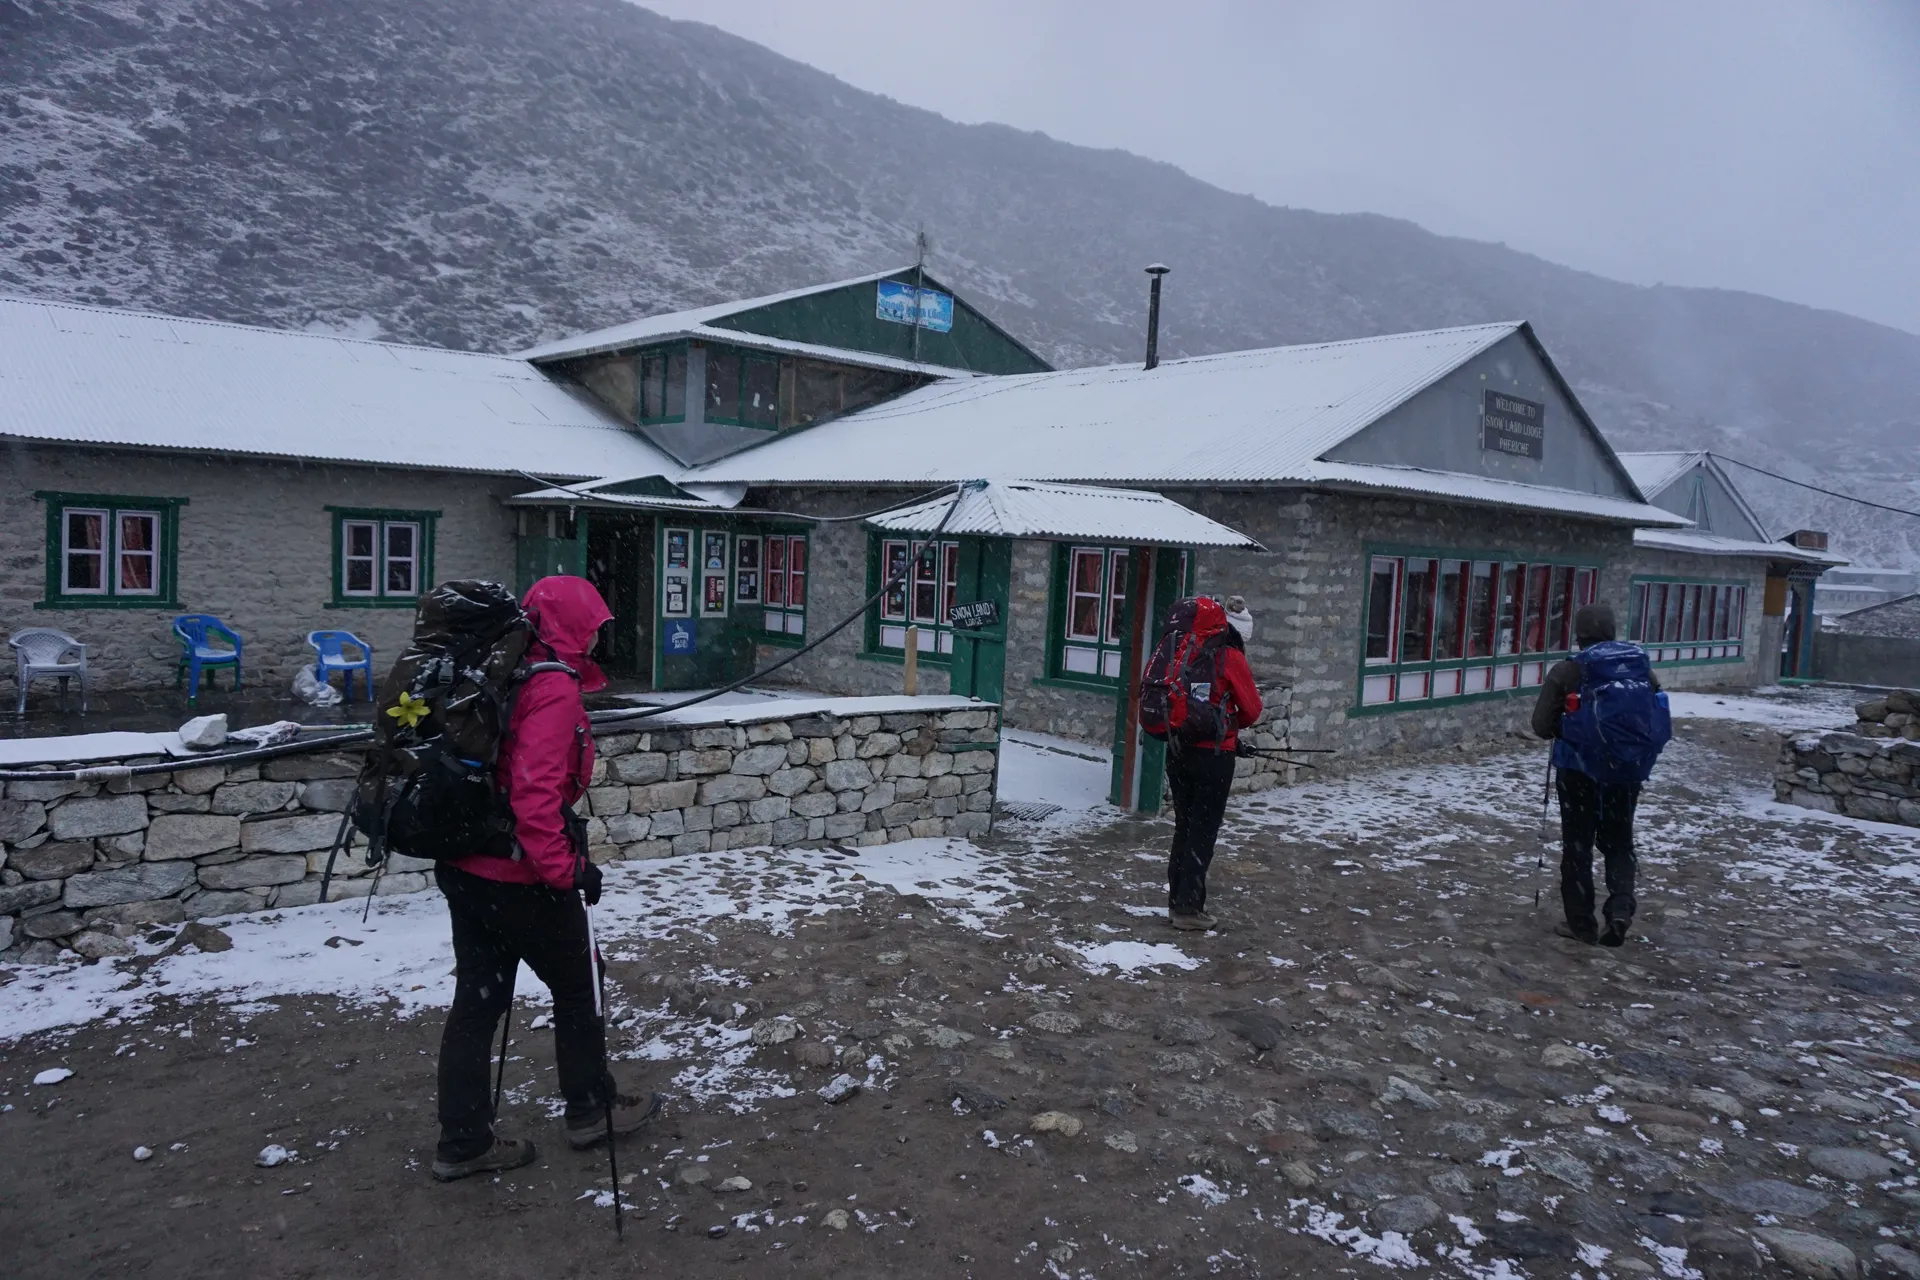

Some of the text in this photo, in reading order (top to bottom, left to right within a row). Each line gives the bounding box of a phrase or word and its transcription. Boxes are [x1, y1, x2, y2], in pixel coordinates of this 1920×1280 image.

[1495, 396, 1536, 420] WELCOME TO
[1485, 414, 1543, 439] SNOW LAND LODGE
[1499, 437, 1529, 455] PHERICHE
[950, 602, 991, 620] SNOW LAND
[964, 616, 983, 627] LODGE
